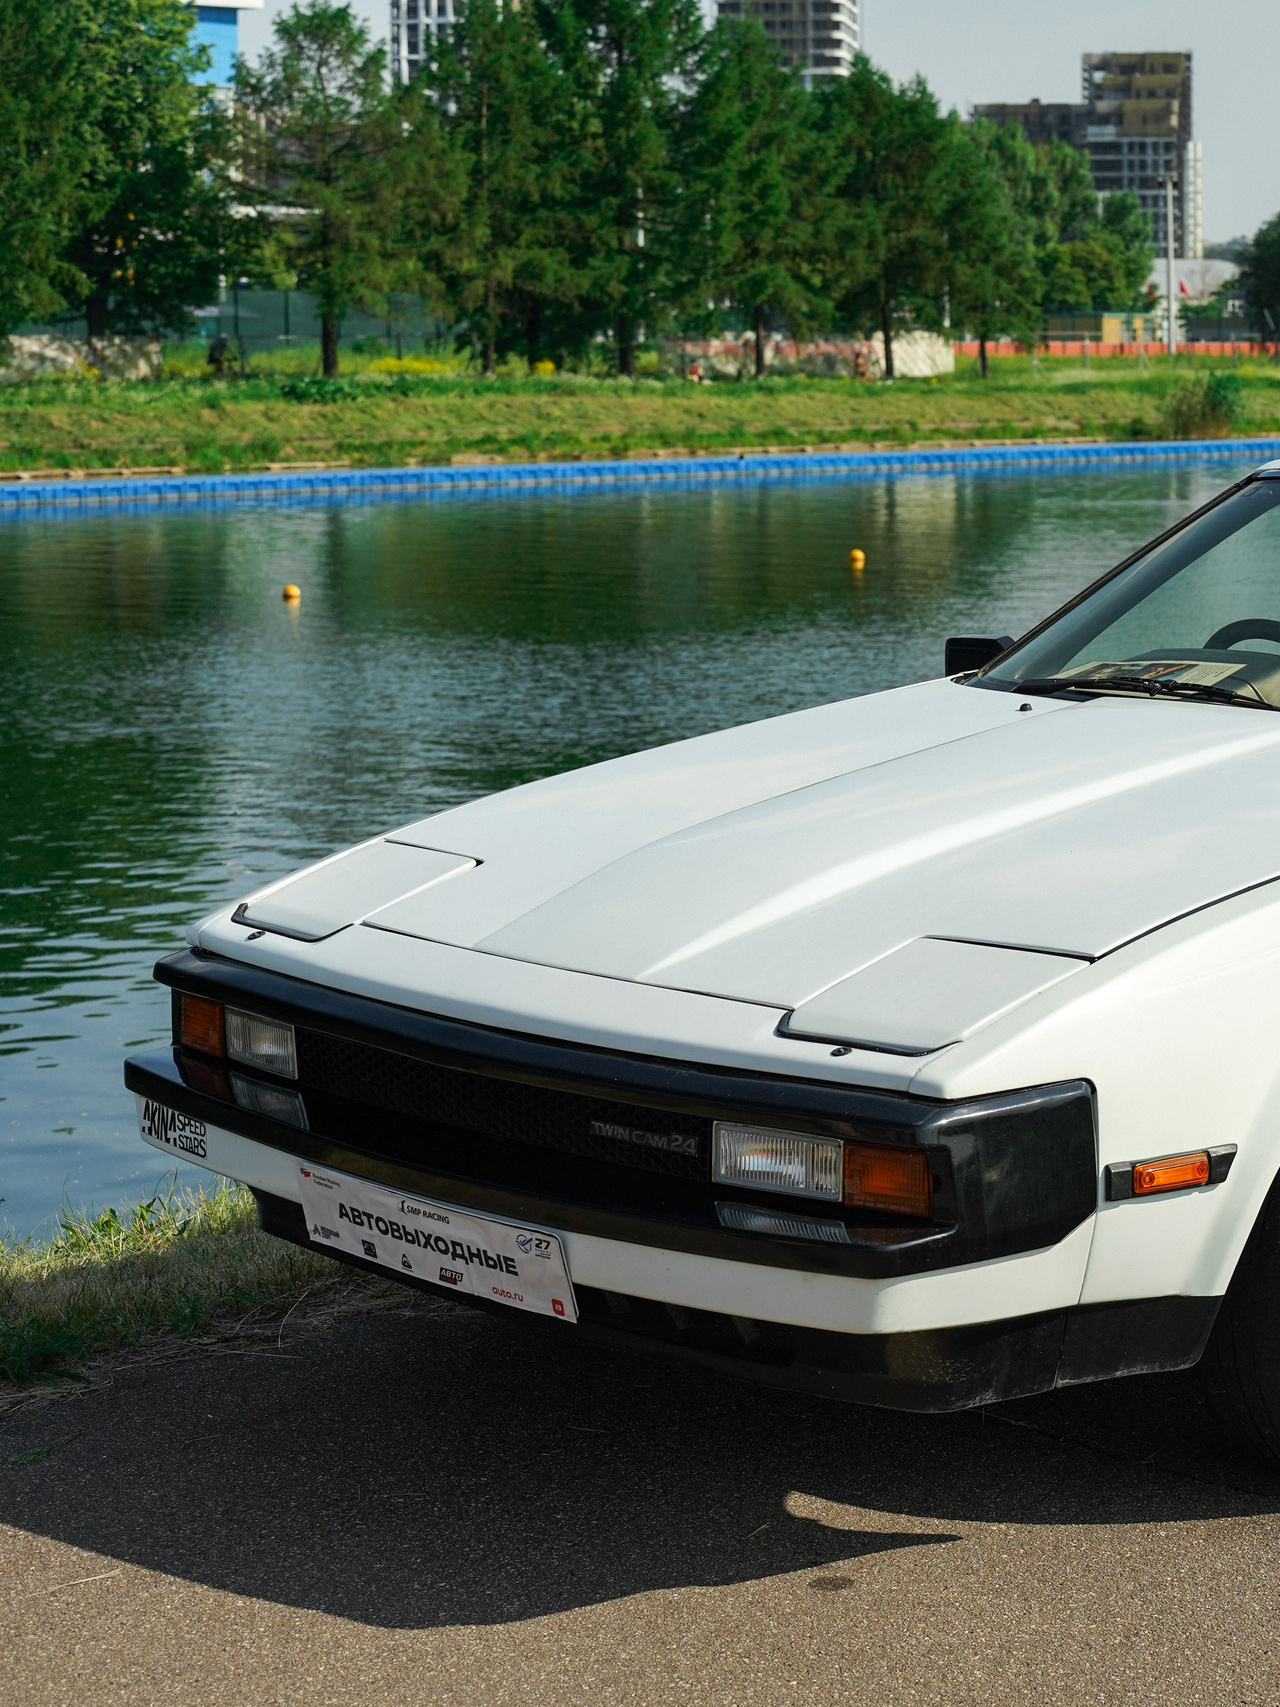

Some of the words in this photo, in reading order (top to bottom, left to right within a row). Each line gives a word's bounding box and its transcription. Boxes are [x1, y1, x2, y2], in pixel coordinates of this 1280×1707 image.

[142, 1099, 177, 1148] AKINA
[177, 1113, 206, 1138] SPEED
[178, 1134, 207, 1158] STARS
[591, 1121, 630, 1141] TWIN
[631, 1131, 668, 1150] CAM
[670, 1135, 697, 1152] 24
[406, 1205, 422, 1217] SMP
[422, 1210, 450, 1224] RACING
[339, 1202, 519, 1277] АВТОВЫХОДНЫЕ
[535, 1238, 551, 1250] 27
[440, 1269, 462, 1281] АВТО
[492, 1286, 524, 1302] auto.ru
